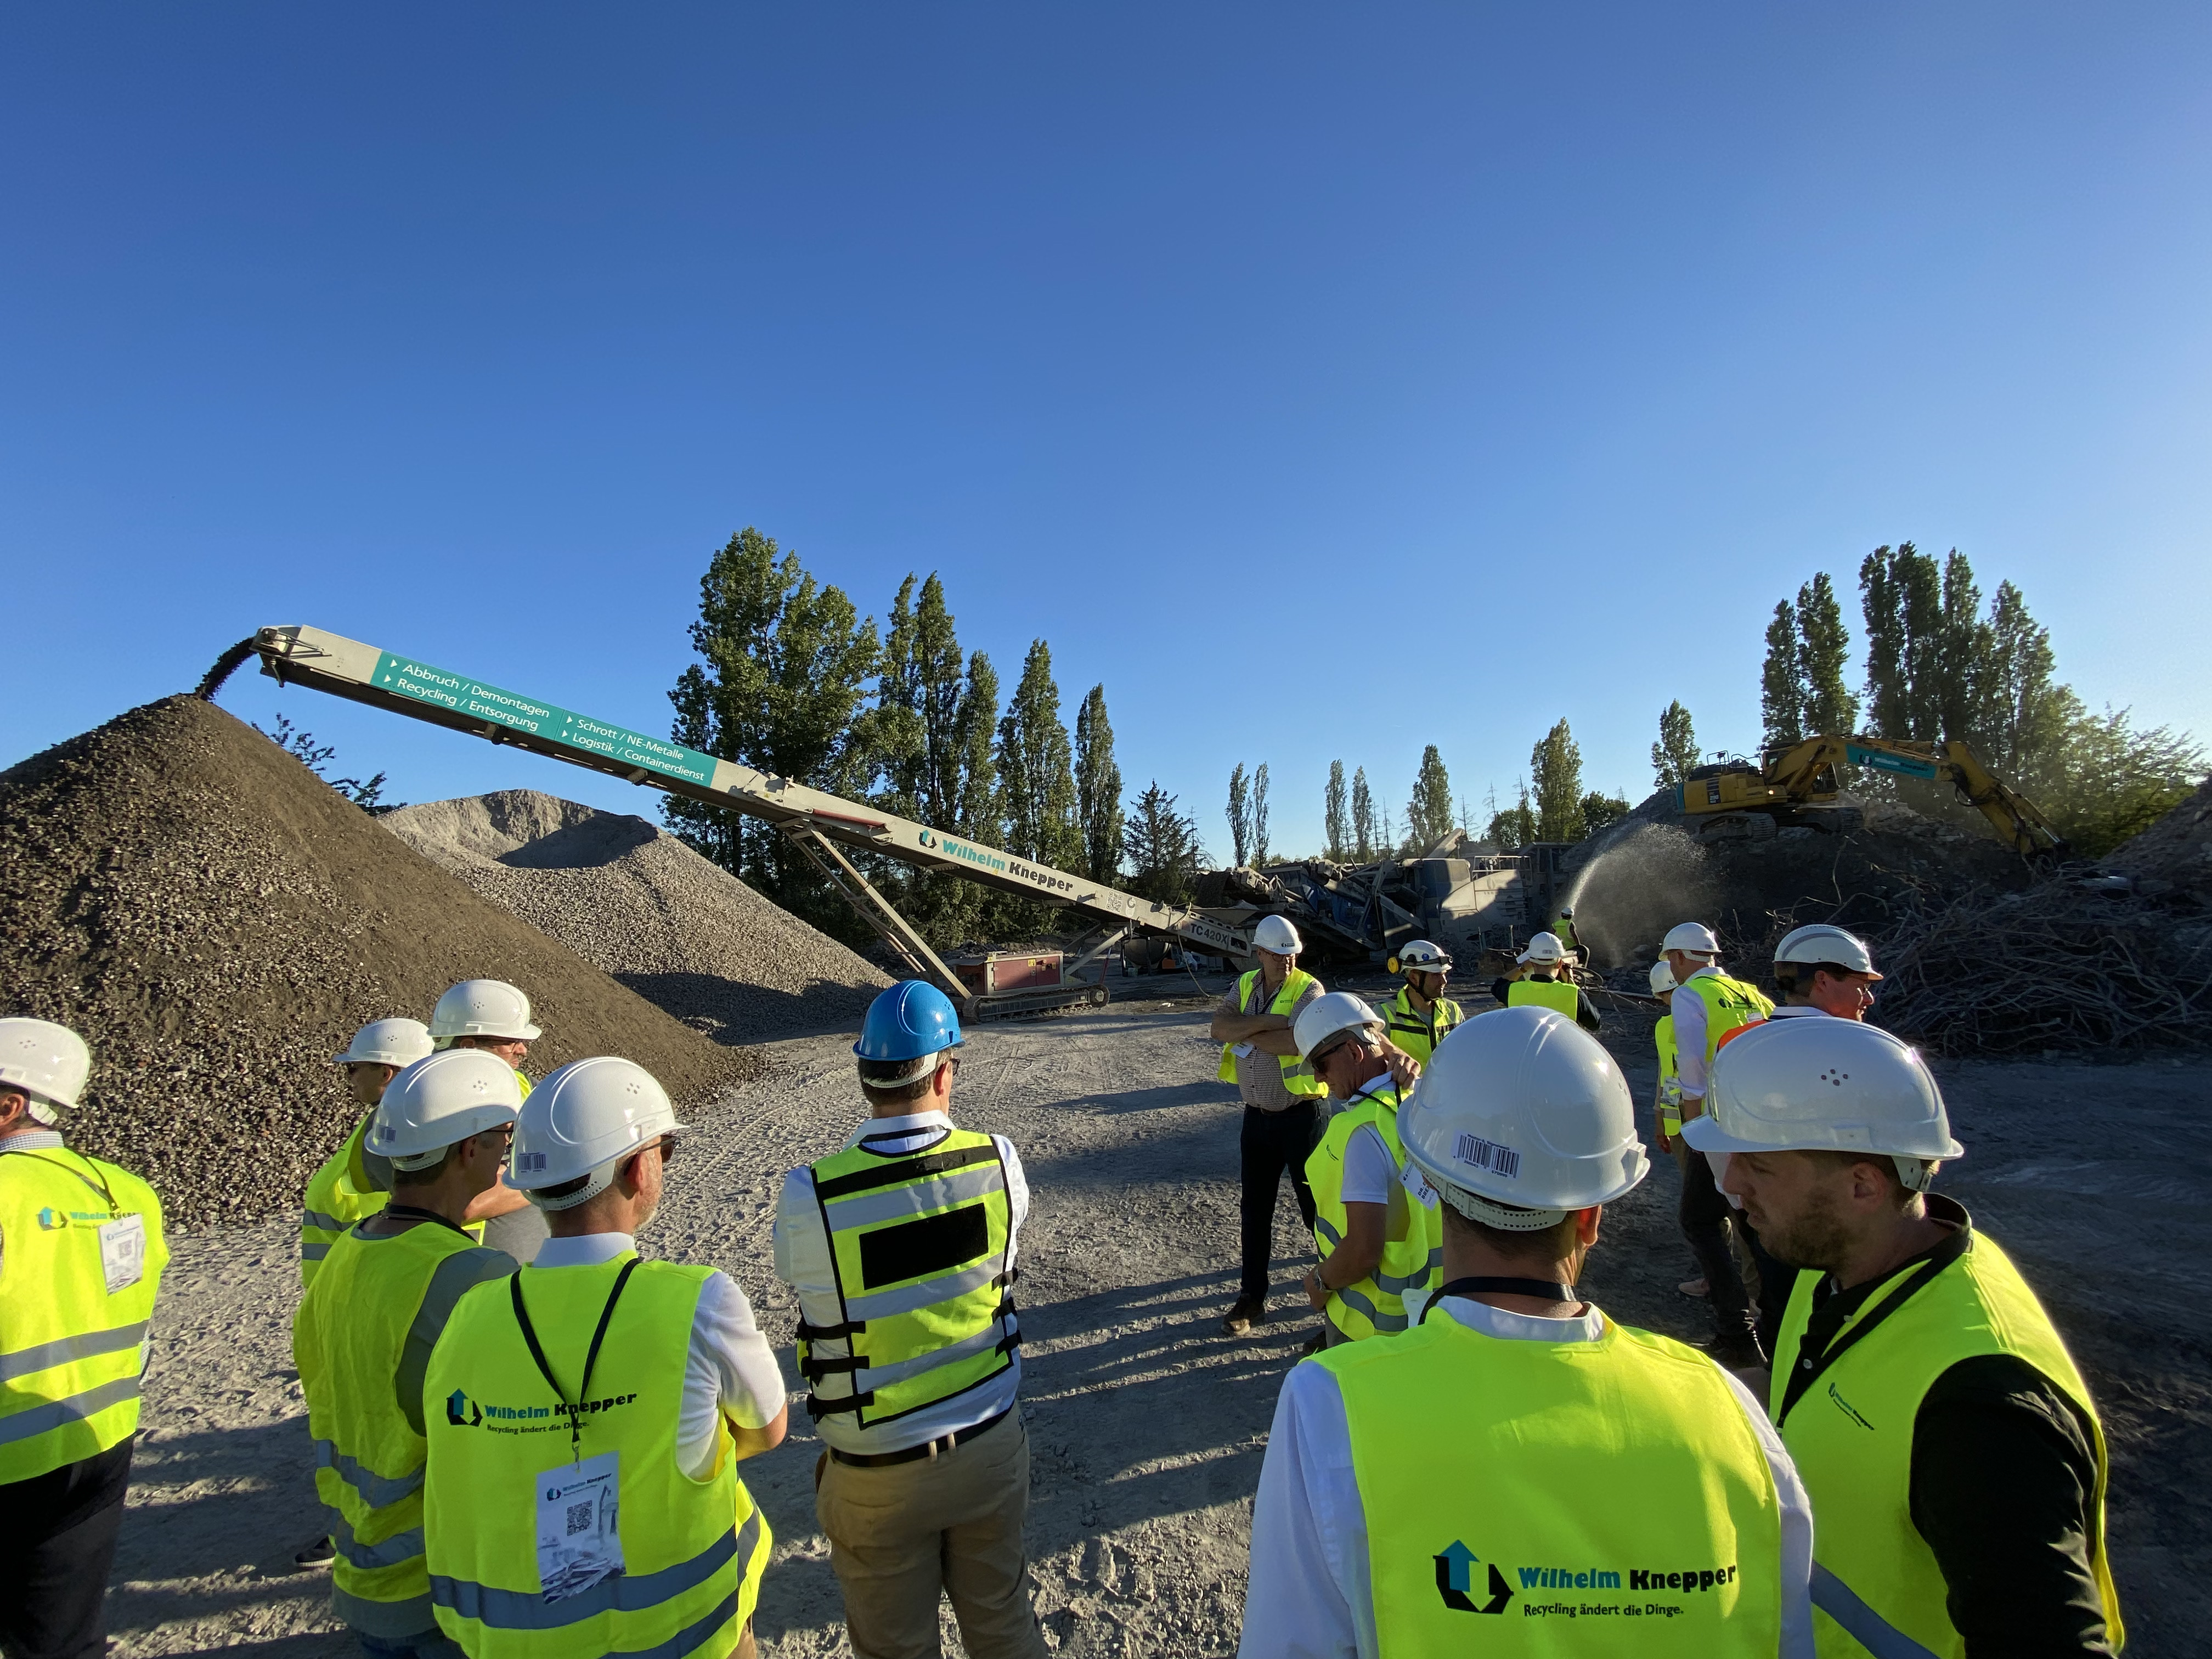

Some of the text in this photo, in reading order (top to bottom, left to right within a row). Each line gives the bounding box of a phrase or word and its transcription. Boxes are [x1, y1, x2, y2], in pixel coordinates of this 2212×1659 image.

[397, 678, 539, 732] Recycling / Entsorgung
[402, 664, 550, 719] Abbruch / Demontagen
[573, 732, 615, 754] Logistik
[624, 749, 705, 781] Containerdienst
[577, 719, 684, 760] Schrott / NE-Metalle
[941, 839, 1074, 892] Wilhelm Knepper
[484, 1392, 637, 1420] Wilhelm Knepper
[487, 1424, 519, 1435] Recycling
[520, 1425, 547, 1434] ändert
[549, 1422, 561, 1432] die
[1517, 1565, 1736, 1593] Wilhelm Knepper
[1523, 1602, 1684, 1618] Recycling ändert die Dinge.
